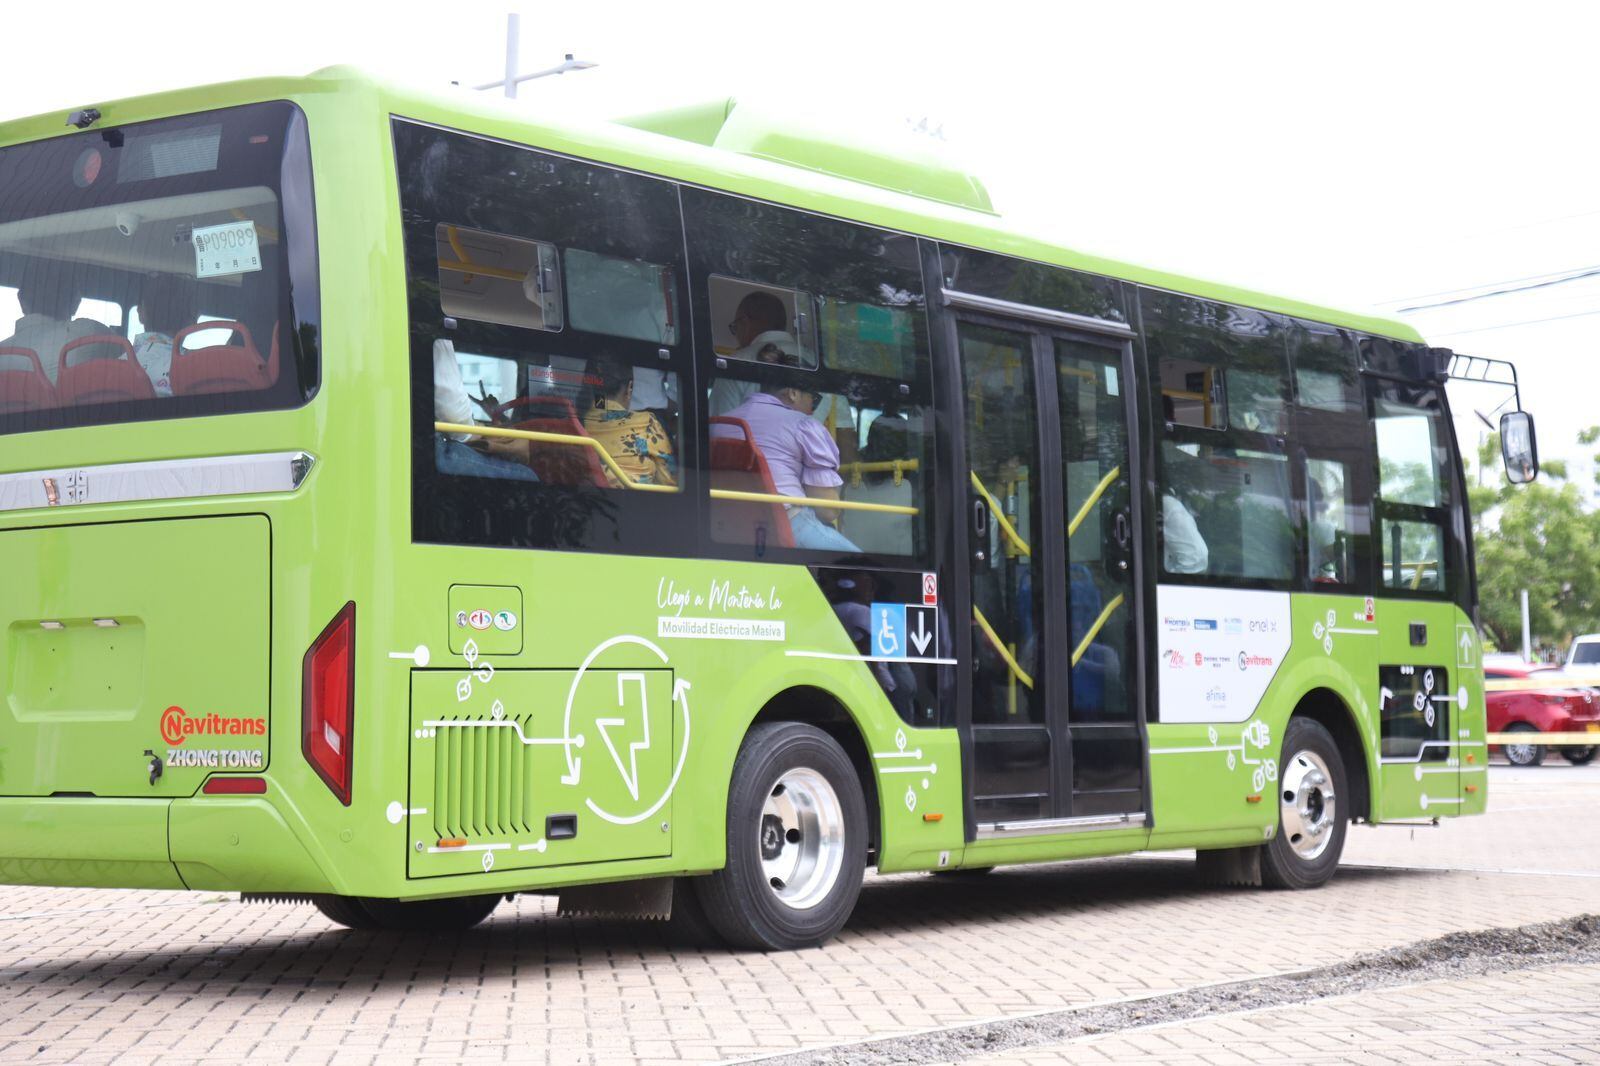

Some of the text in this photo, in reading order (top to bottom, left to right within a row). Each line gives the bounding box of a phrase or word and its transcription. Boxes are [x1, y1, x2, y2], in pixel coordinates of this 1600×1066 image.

[657, 576, 782, 617] Llegó a Montería la
[662, 621, 781, 637] Movilidad Eléctrica Masiva
[1238, 650, 1273, 671] Navitrans
[160, 705, 266, 746] Navitrans
